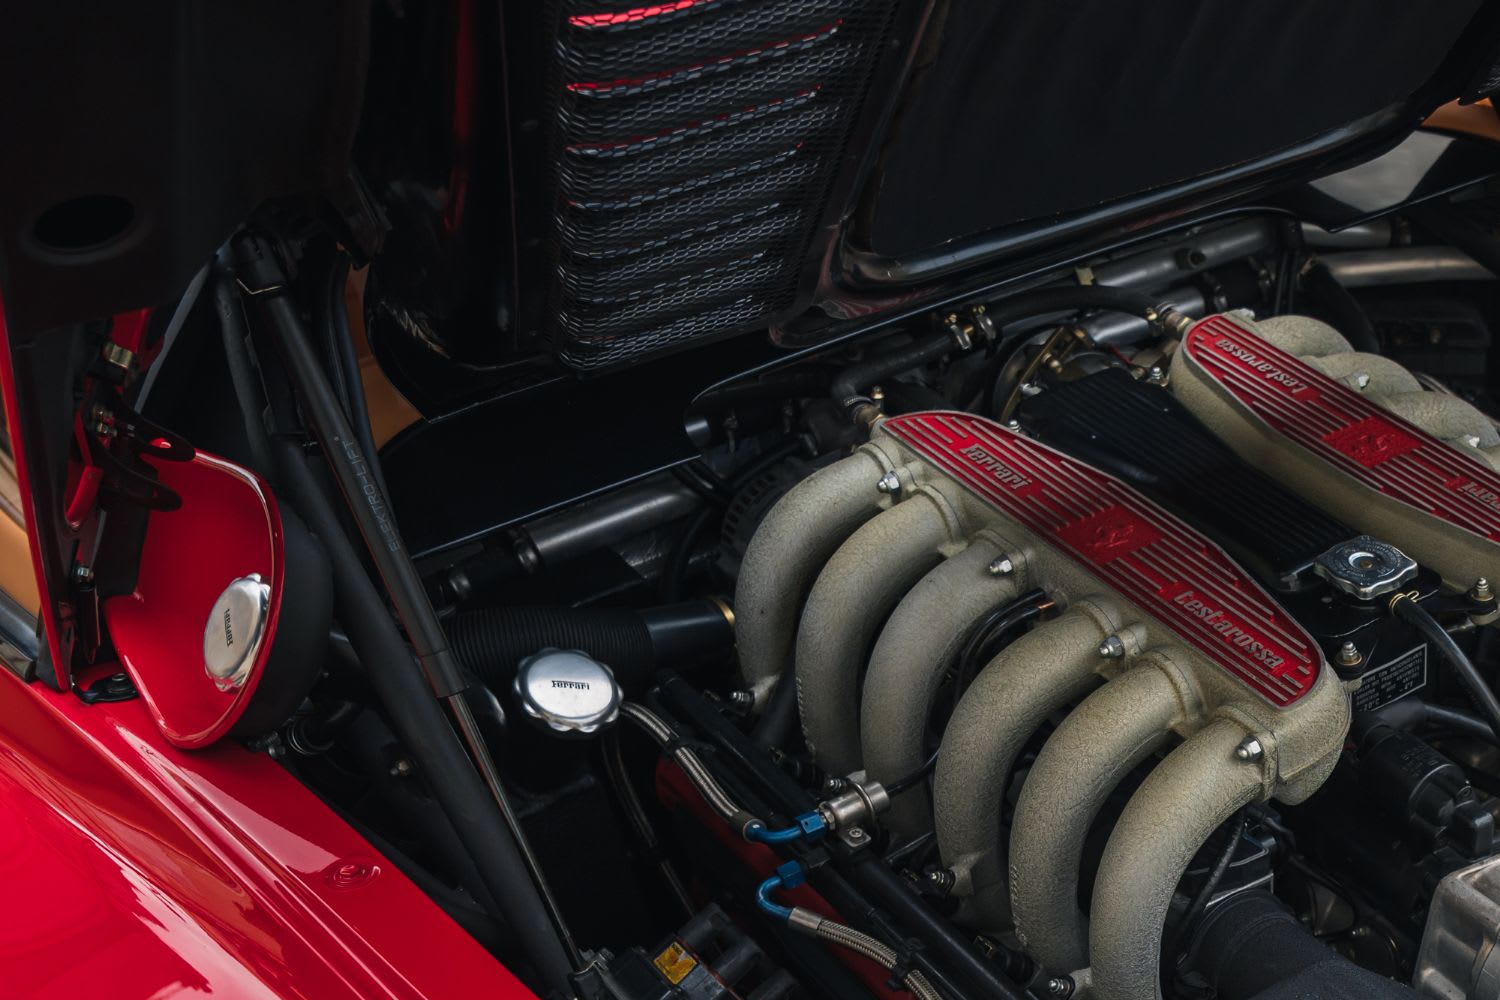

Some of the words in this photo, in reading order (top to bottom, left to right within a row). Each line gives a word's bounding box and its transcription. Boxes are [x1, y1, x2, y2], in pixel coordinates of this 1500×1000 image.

[1214, 335, 1306, 397] testarossa
[341, 439, 401, 552] ELEKTRO-LIFT
[960, 443, 1032, 490] Ferrari
[1174, 590, 1284, 670] testarossa
[551, 679, 590, 691] Ferrari
